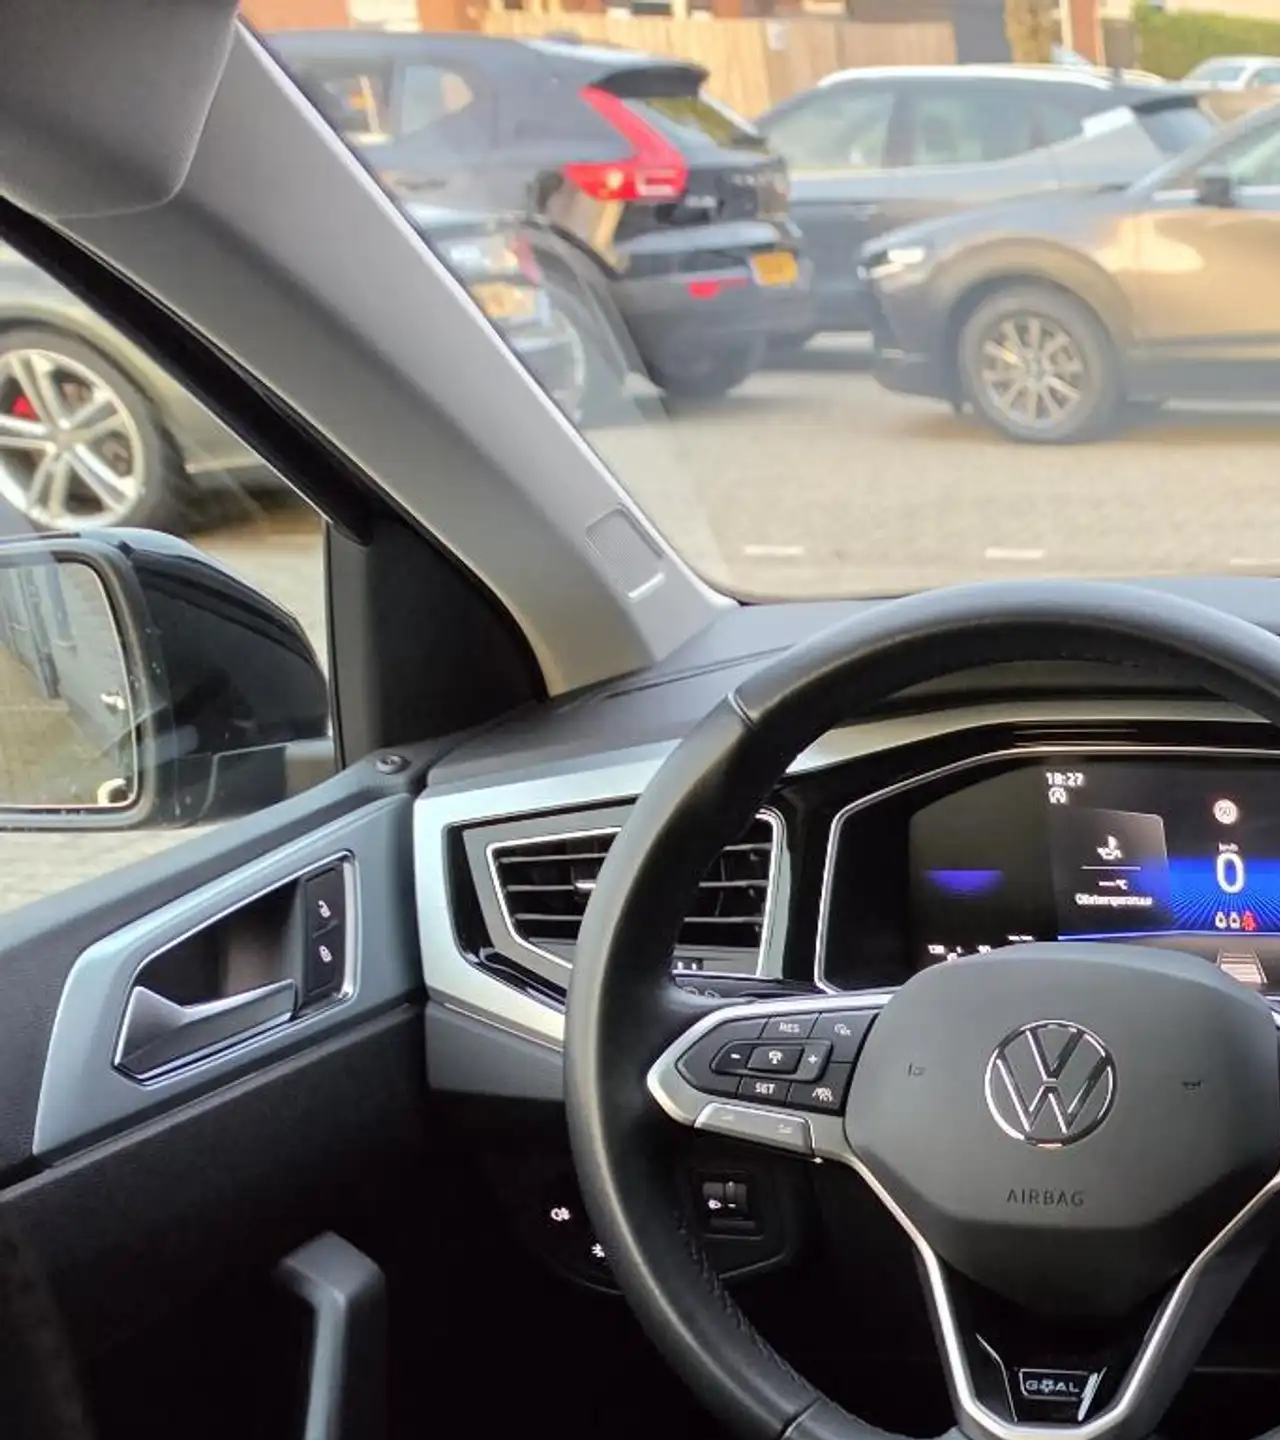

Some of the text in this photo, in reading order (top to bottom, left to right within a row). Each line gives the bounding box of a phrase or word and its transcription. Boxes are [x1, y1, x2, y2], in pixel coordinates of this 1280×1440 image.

[1216, 852, 1245, 893] 0
[779, 1022, 799, 1033] RES
[755, 1082, 776, 1094] SET
[1006, 1187, 1085, 1208] AIRBAG
